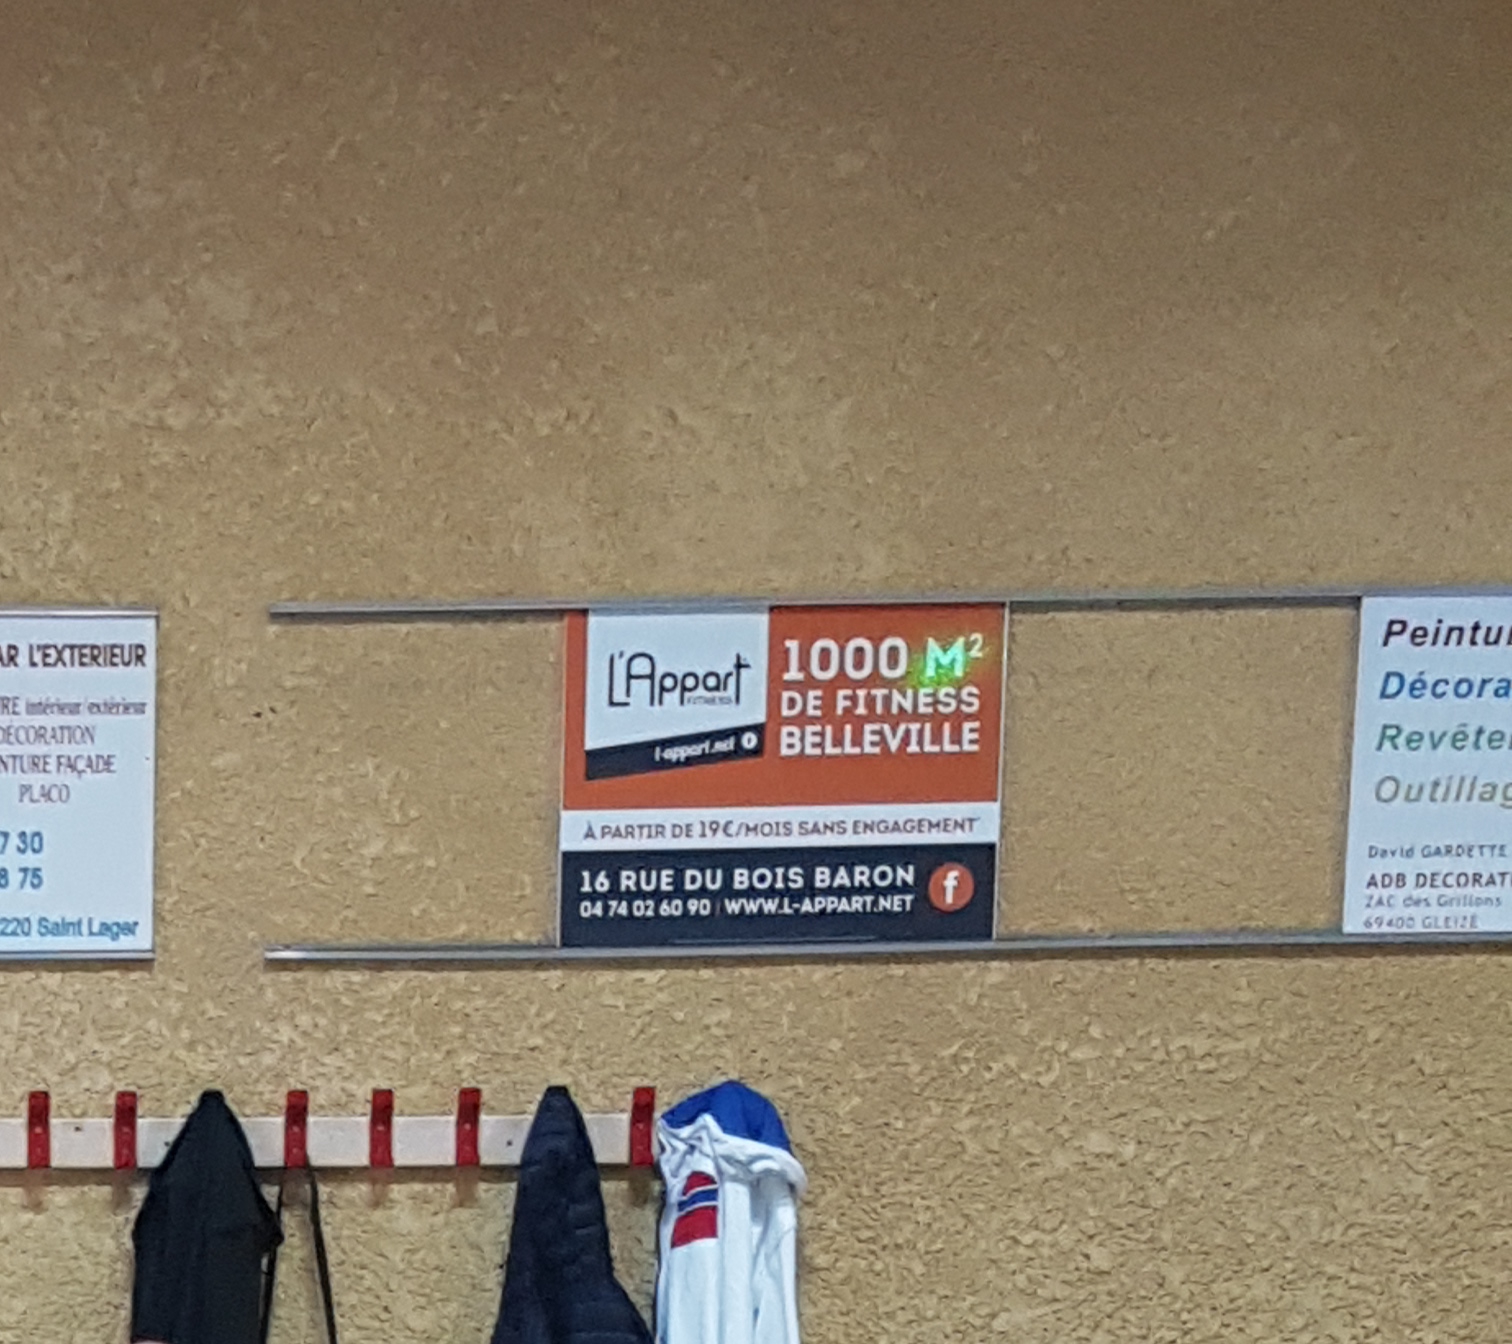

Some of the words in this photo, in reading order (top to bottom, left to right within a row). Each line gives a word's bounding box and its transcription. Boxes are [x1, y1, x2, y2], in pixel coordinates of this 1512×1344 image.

[28, 643, 147, 668] L'EXTERIEUR
[782, 636, 909, 682] 1000
[608, 651, 752, 707] L'Appart
[781, 688, 823, 718] DE
[835, 685, 981, 716] FITNESS
[779, 720, 981, 758] BELLEVILLE
[1375, 723, 1512, 751] Revête
[56, 754, 117, 779] FAÇADE
[18, 784, 71, 804] PLACO
[601, 823, 666, 841] PARTIR
[671, 823, 694, 839] DE
[797, 819, 847, 836] SANS
[16, 831, 43, 855] 30
[1368, 845, 1415, 859] David
[18, 867, 43, 889] 75
[580, 869, 610, 893] 16
[620, 868, 674, 892] RUE
[684, 868, 723, 891] DU
[733, 866, 805, 890] BOIS
[814, 864, 916, 889] BARON
[1366, 872, 1407, 889] ADB
[580, 899, 603, 918] 04
[608, 899, 628, 918] 74
[633, 899, 655, 917] 02
[659, 898, 683, 917] 60
[688, 897, 711, 917] 90
[724, 894, 915, 916] WWW.L-APPART.NET
[38, 916, 84, 938] Saint
